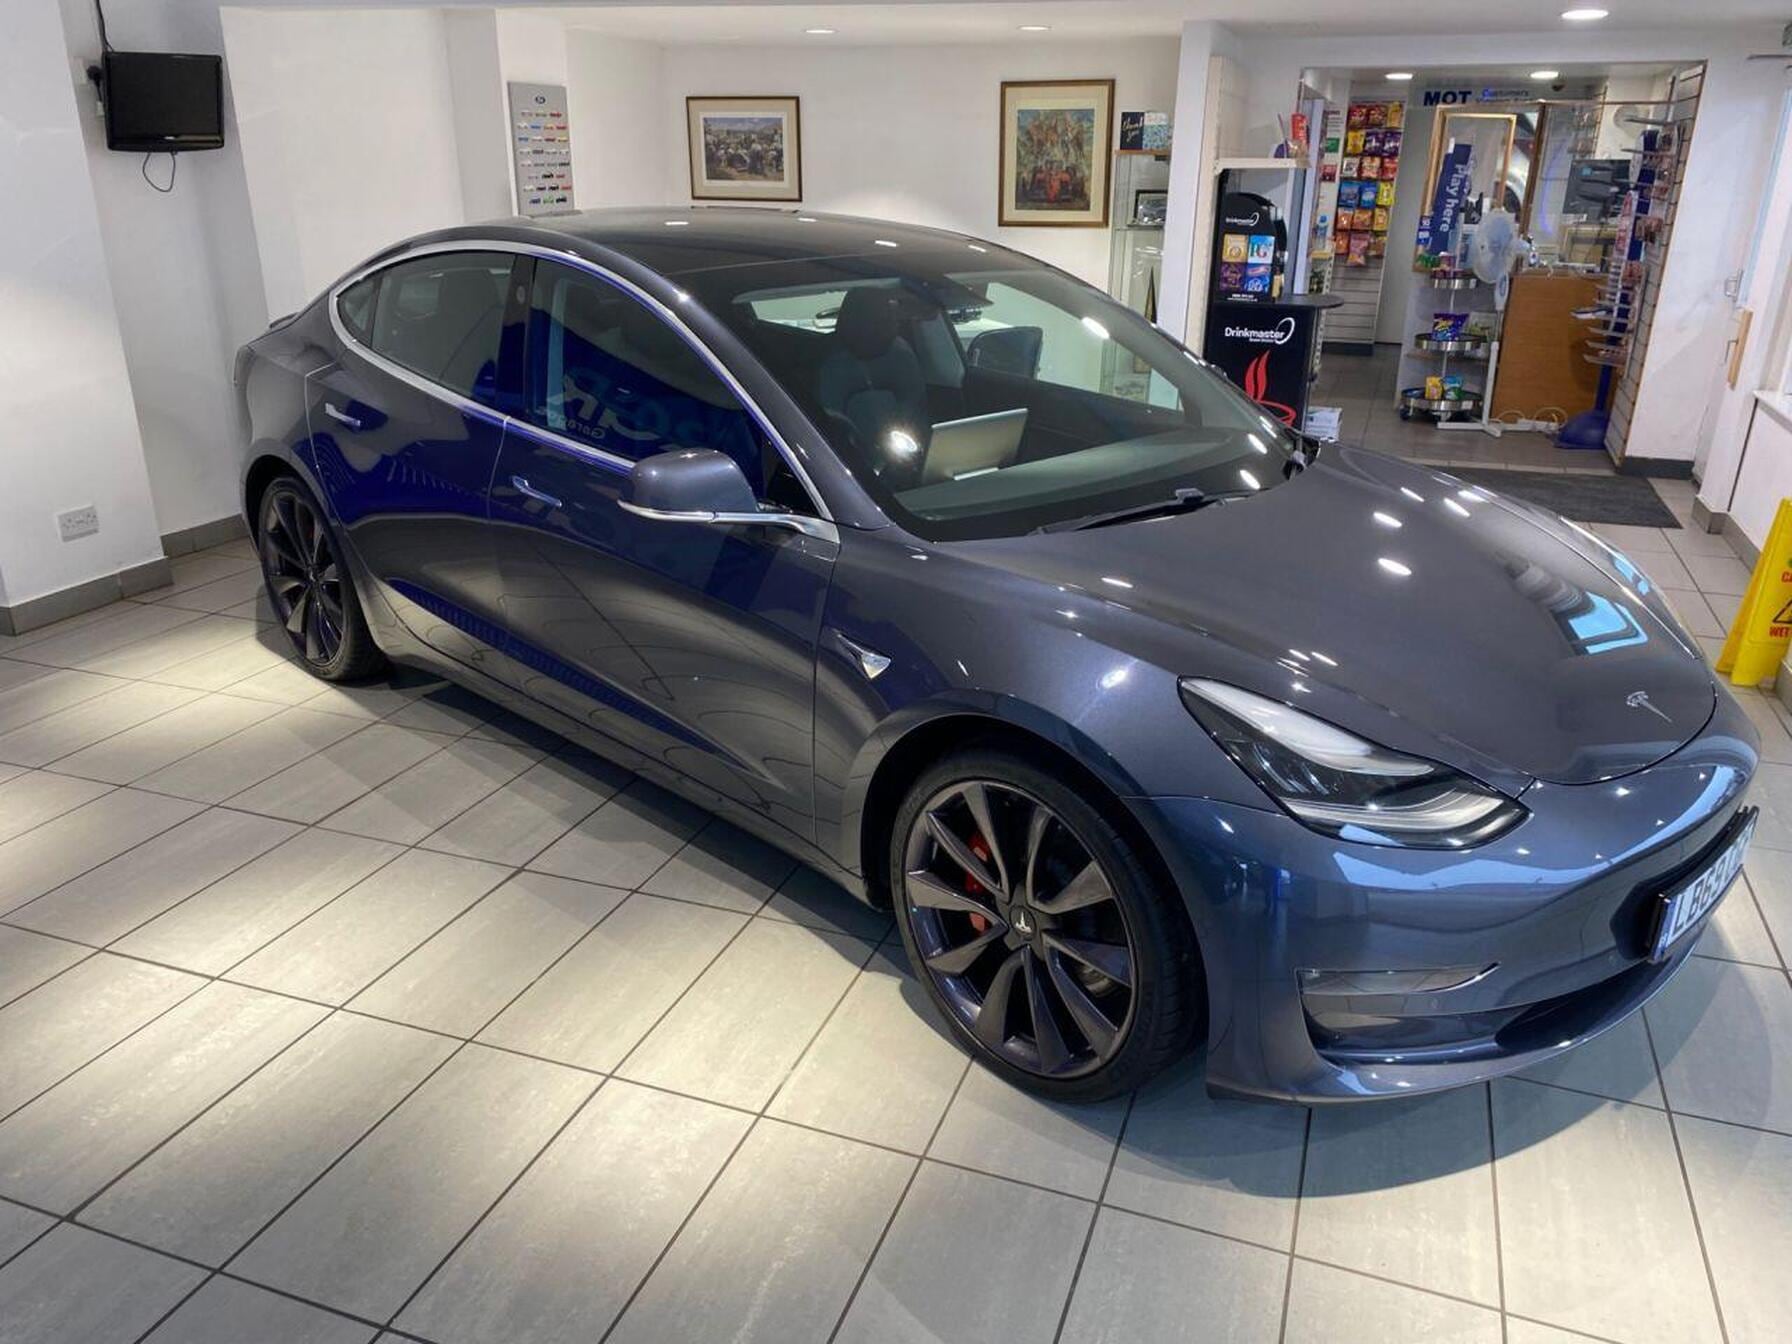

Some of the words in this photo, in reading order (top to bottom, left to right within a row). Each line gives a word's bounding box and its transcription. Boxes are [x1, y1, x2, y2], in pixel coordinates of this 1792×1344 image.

[1423, 91, 1472, 106] MOT
[1440, 199, 1459, 232] here
[1224, 326, 1285, 339] Drinkmaster
